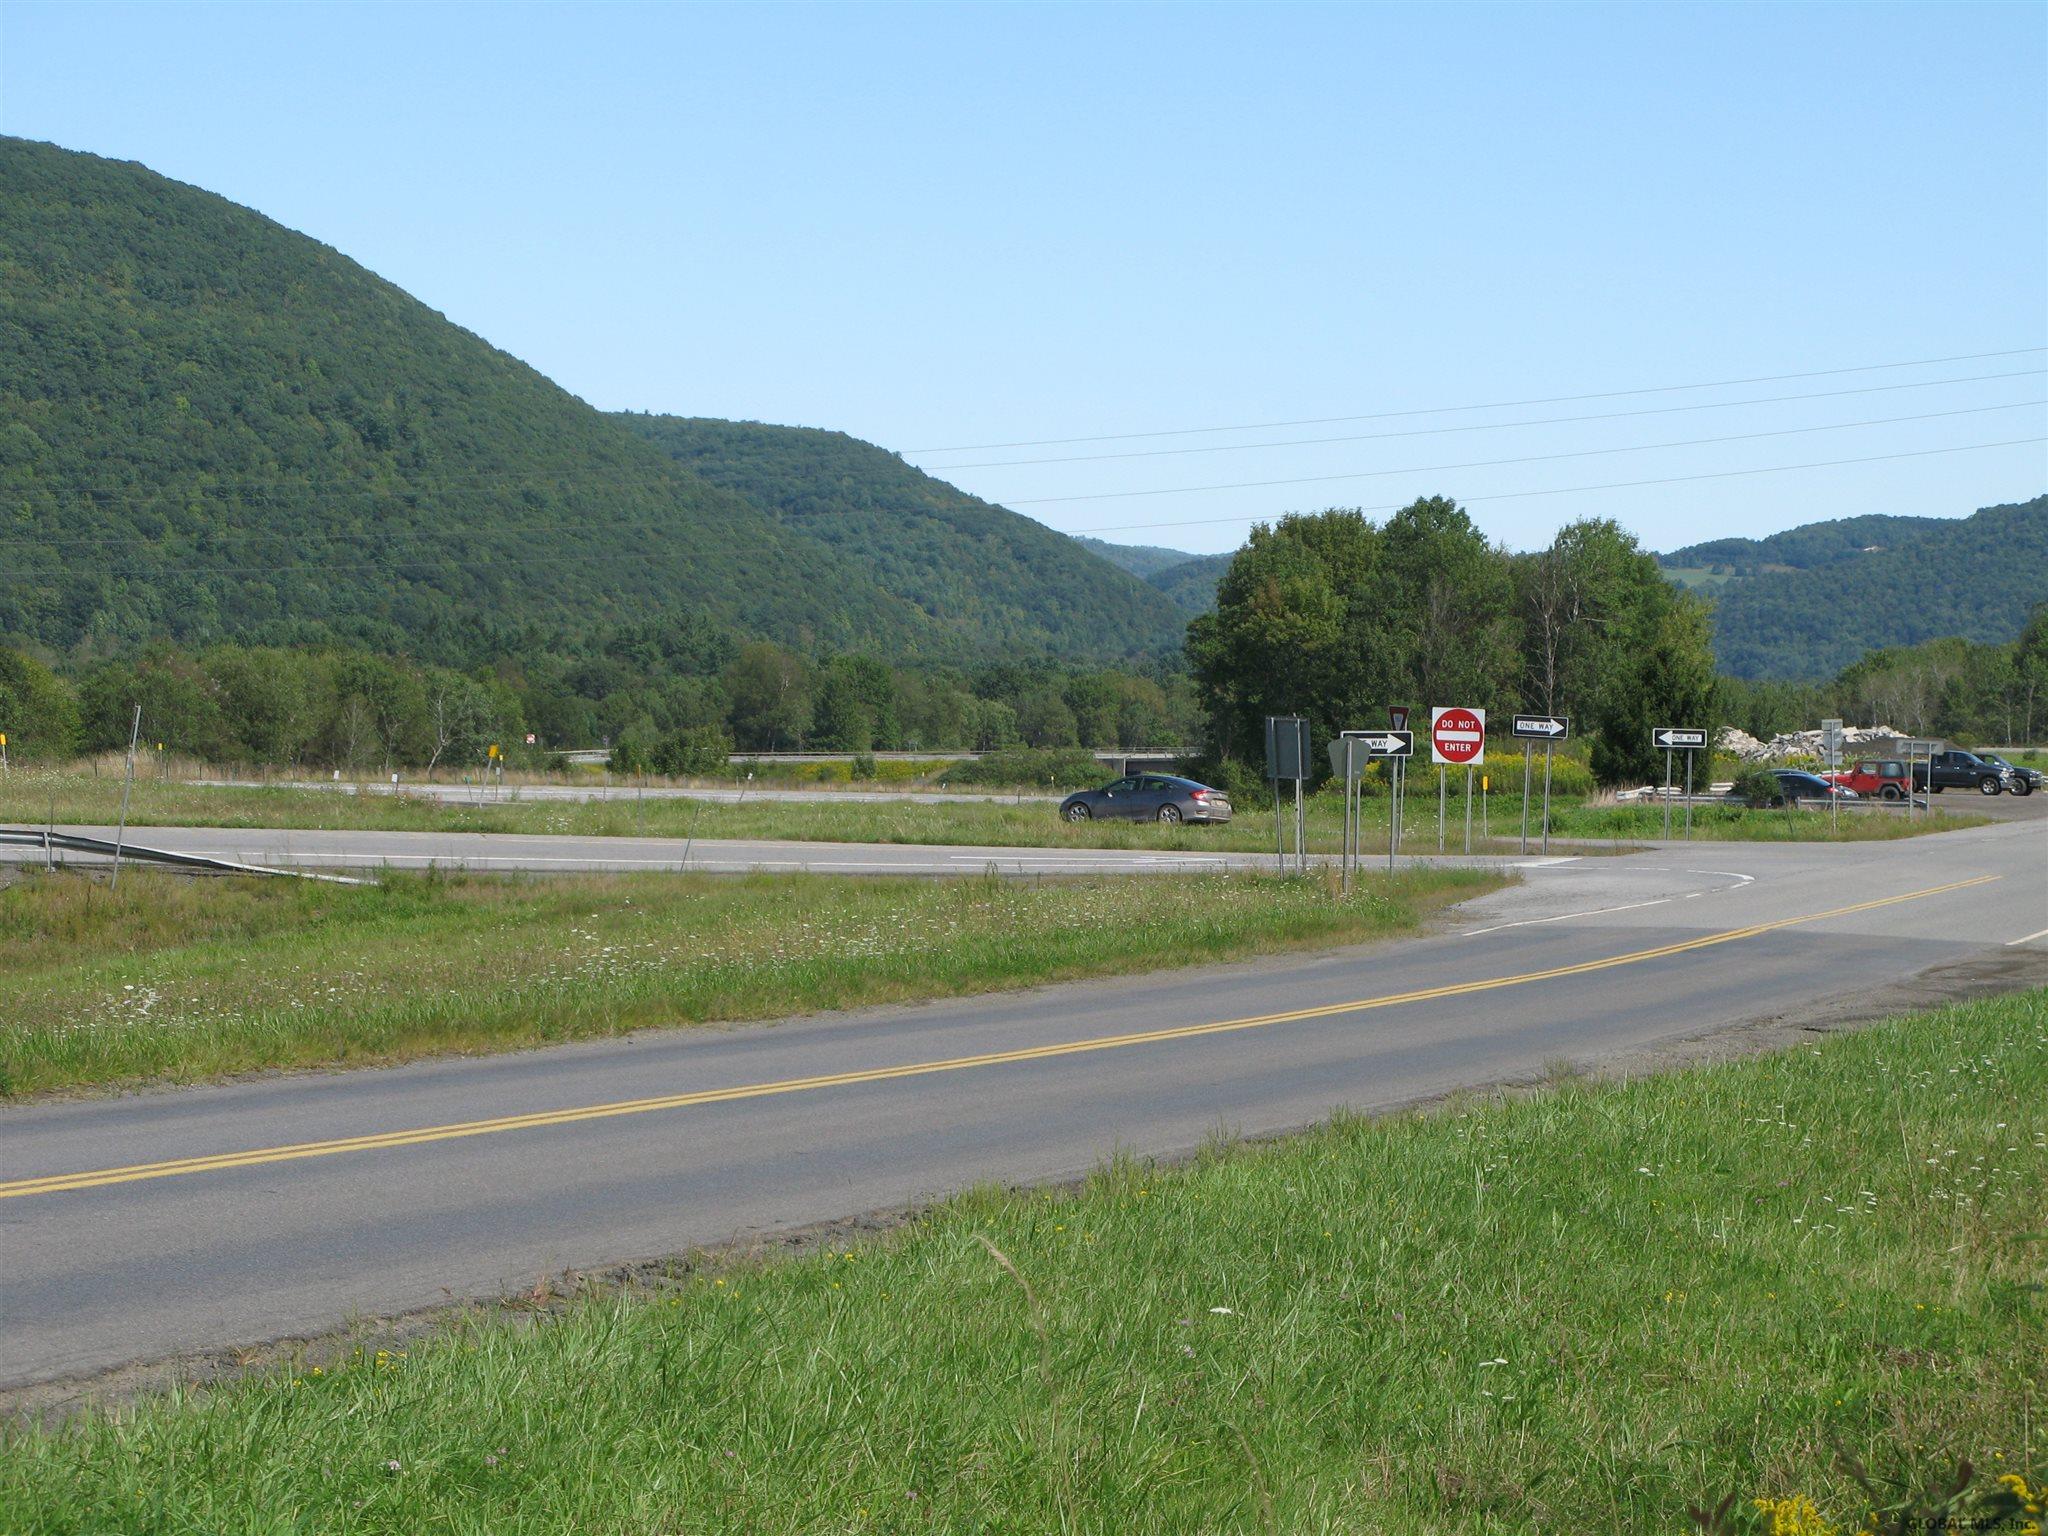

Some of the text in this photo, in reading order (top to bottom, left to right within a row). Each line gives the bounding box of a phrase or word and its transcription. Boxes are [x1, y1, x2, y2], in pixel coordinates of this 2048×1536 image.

[1441, 719, 1476, 729] DO NOT
[1520, 722, 1554, 731] ONE WAY
[1371, 739, 1388, 748] WAY
[1444, 742, 1472, 752] ENTER
